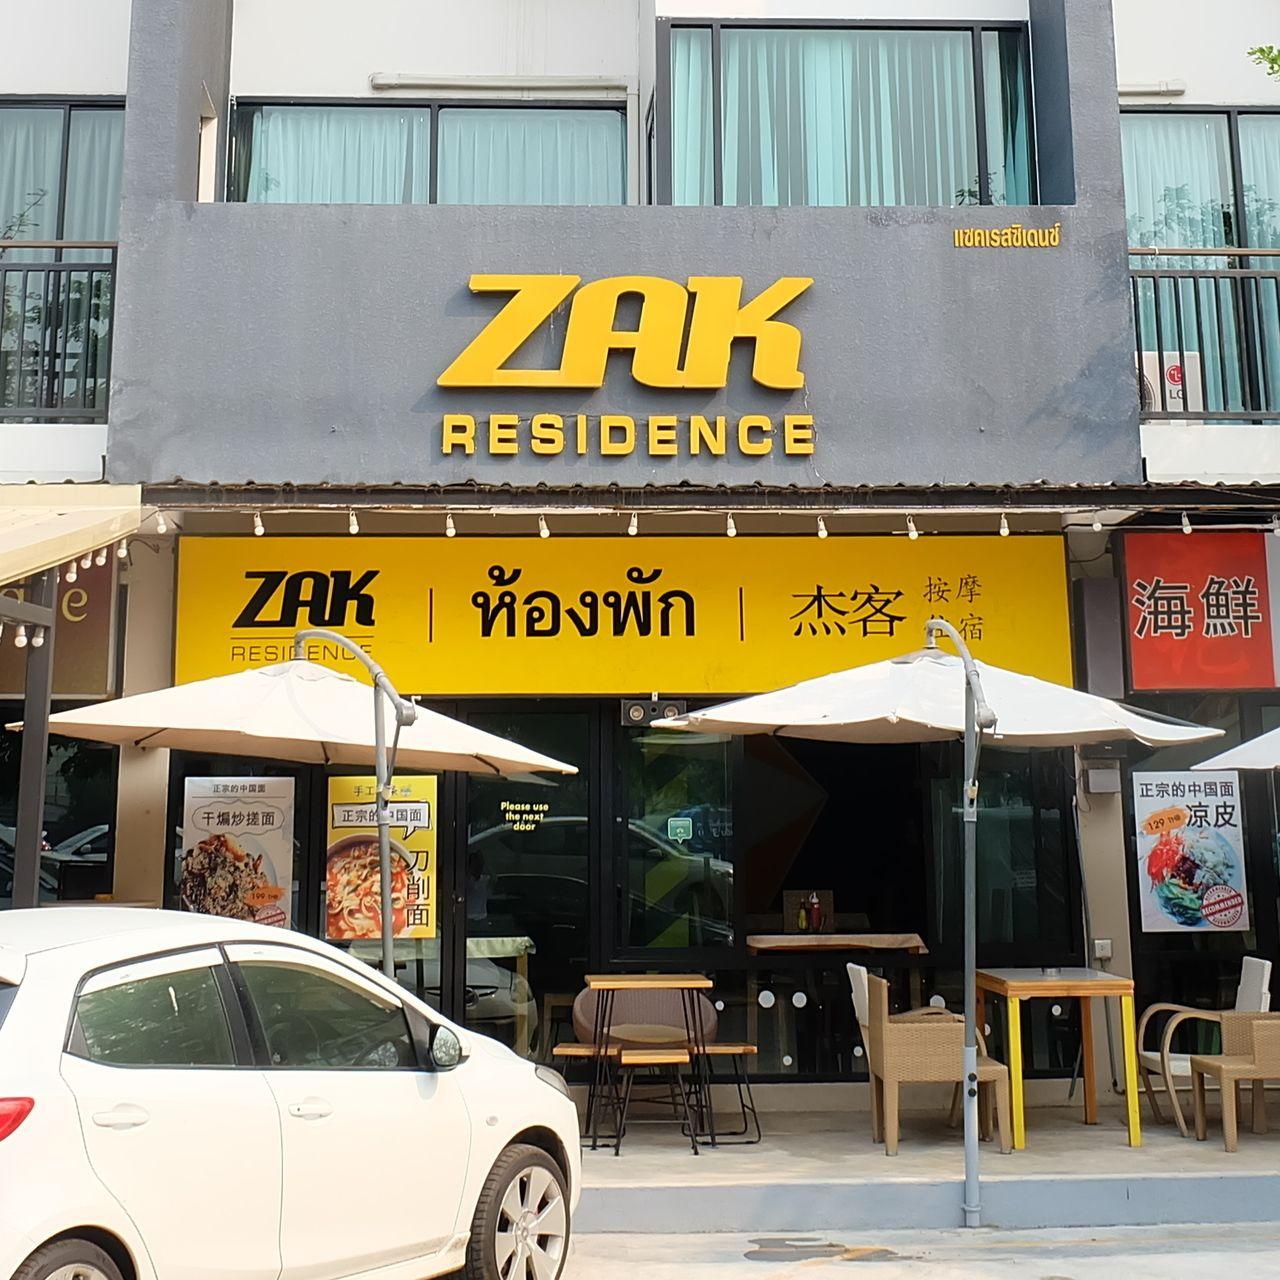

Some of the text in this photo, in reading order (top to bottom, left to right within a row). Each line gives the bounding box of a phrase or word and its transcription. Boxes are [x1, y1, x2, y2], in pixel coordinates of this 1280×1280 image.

[436, 273, 814, 391] ZAK
[442, 413, 815, 456] RESIDENCE
[231, 570, 381, 628] ZAK
[471, 565, 696, 638] ห้องพัก
[923, 574, 983, 604] 按摩
[789, 584, 908, 638] 杰客
[1132, 575, 1263, 640] 海鮮
[500, 801, 549, 812] Please use
[1139, 781, 1235, 798] 正宗的中国面
[505, 812, 544, 821] the next
[513, 821, 536, 831] door
[1147, 818, 1165, 832] 129
[1185, 801, 1238, 829] 凉皮
[406, 849, 430, 928] 刀削面
